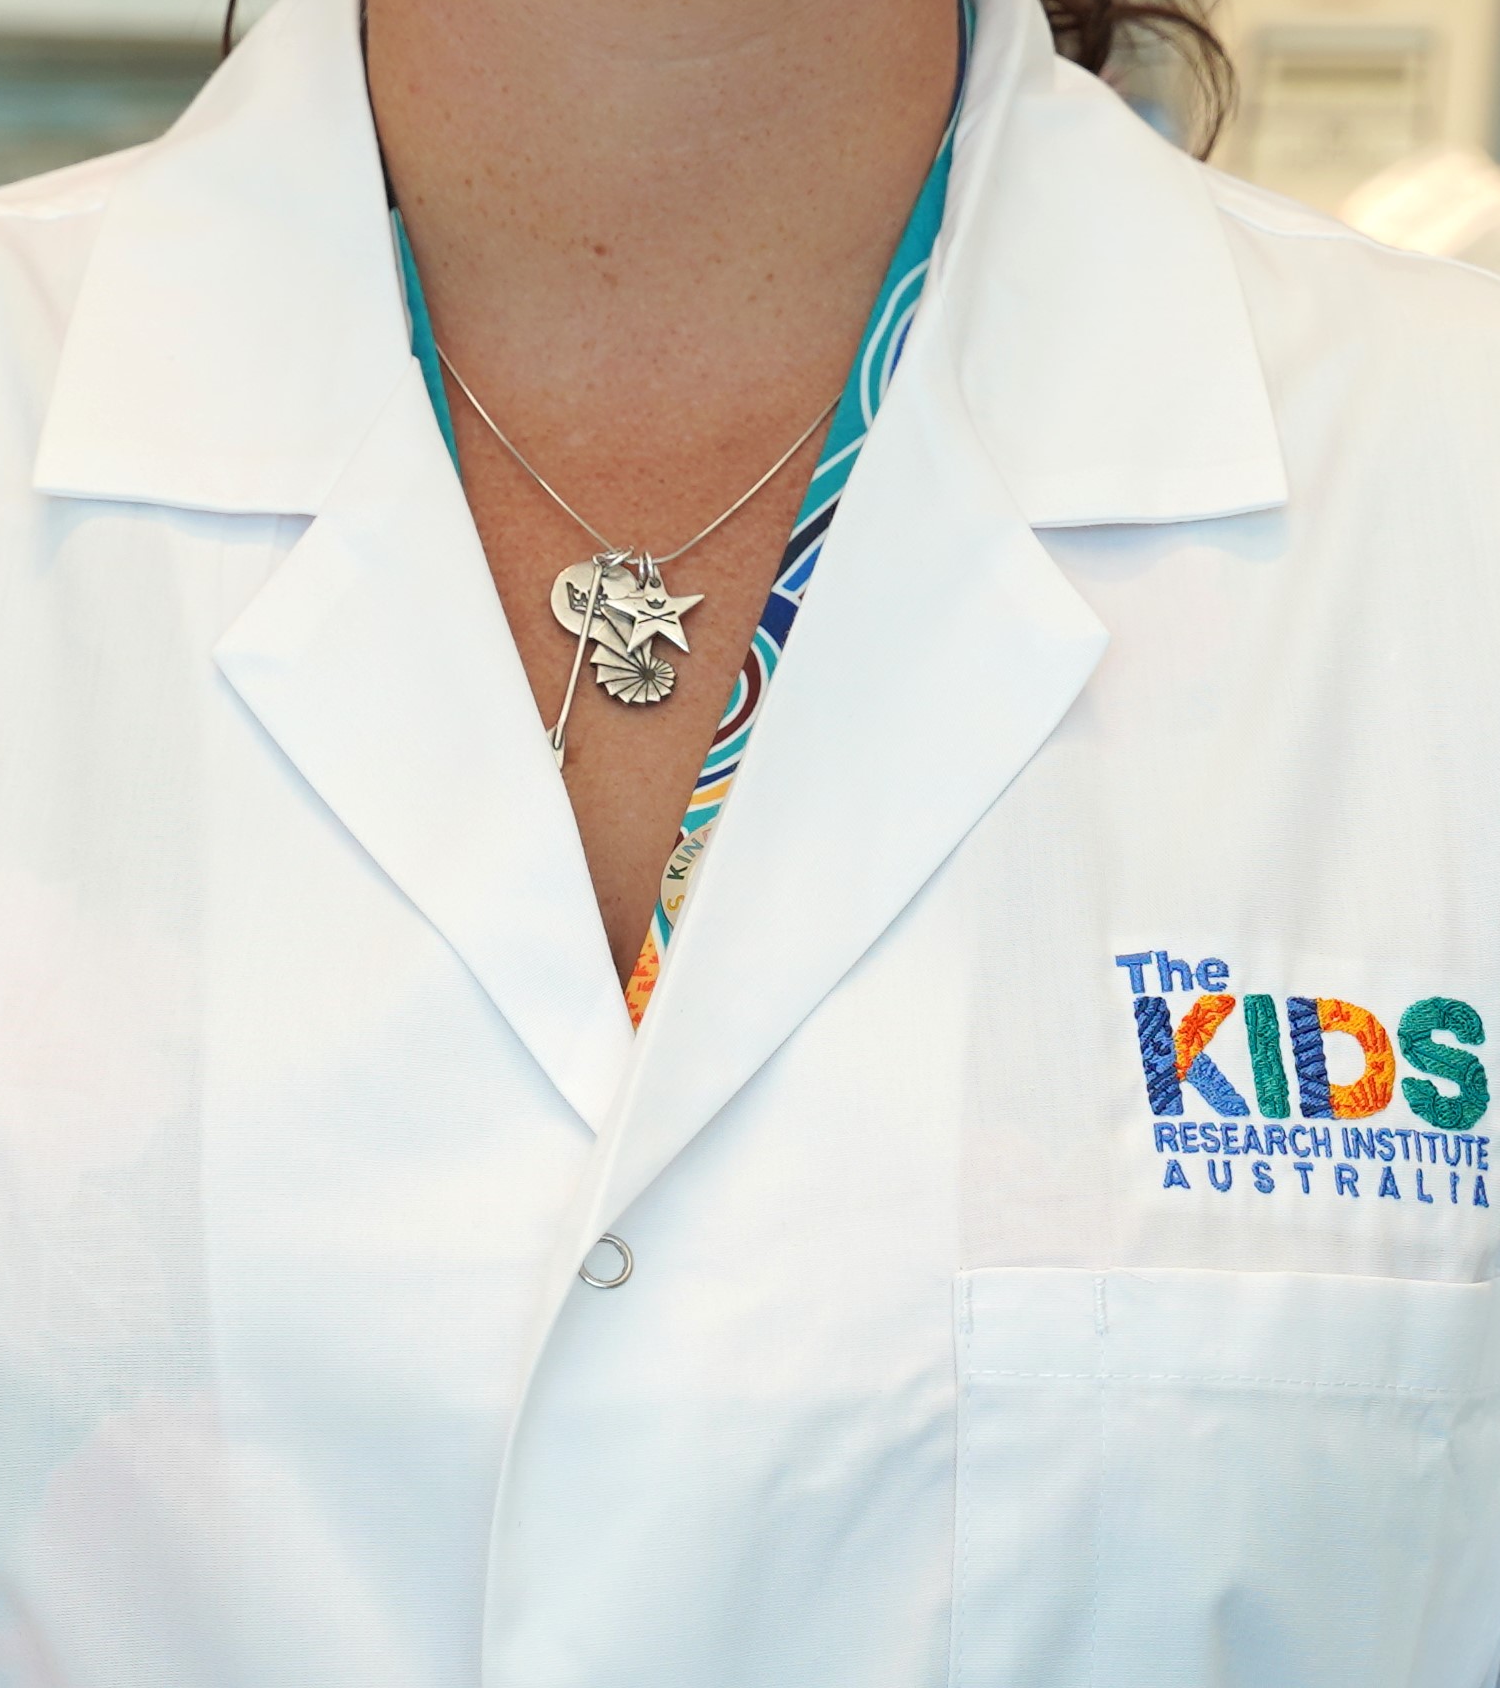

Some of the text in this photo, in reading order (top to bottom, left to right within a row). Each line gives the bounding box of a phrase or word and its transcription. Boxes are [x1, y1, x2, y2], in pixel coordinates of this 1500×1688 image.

[1115, 951, 1230, 995] The
[1133, 993, 1491, 1131] KIDS
[1153, 1122, 1490, 1171] RESEARCH INSTITUTE
[1163, 1159, 1490, 1208] AUSTRALIA
